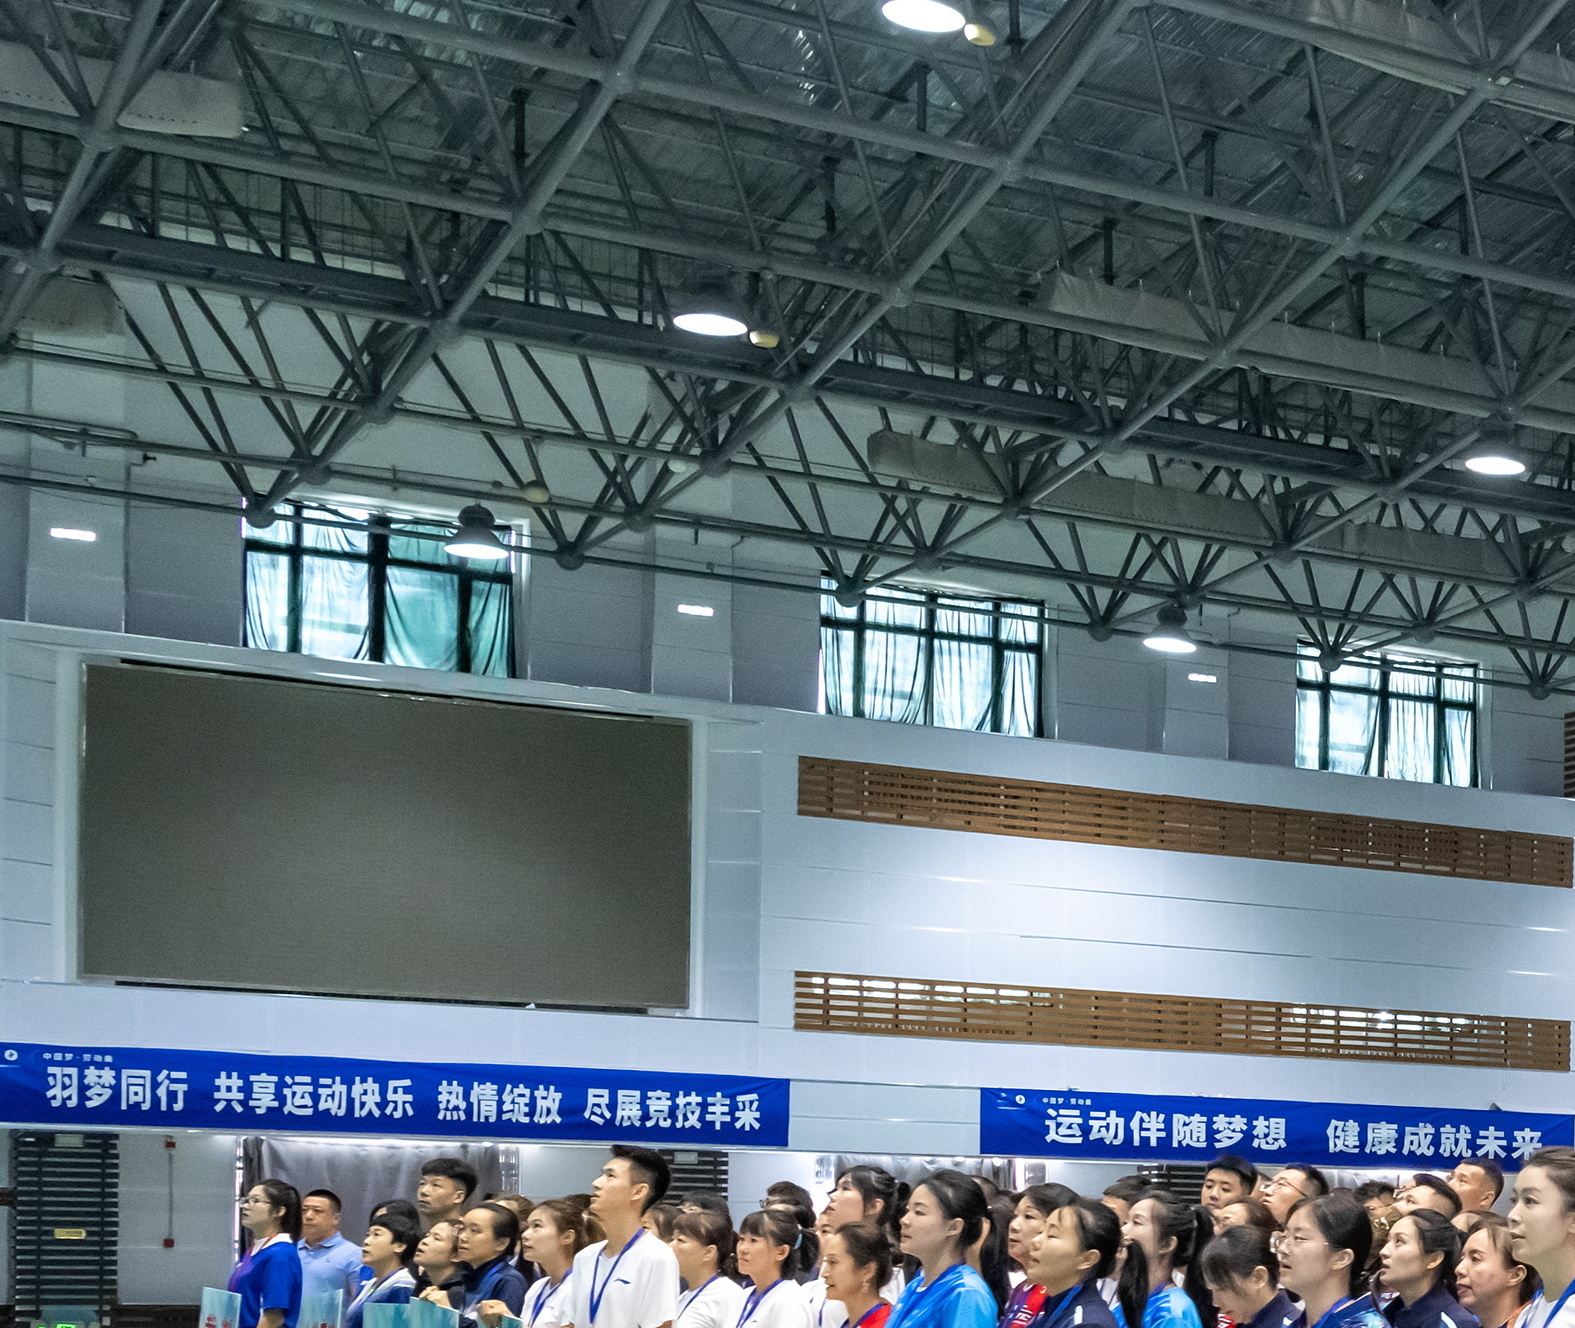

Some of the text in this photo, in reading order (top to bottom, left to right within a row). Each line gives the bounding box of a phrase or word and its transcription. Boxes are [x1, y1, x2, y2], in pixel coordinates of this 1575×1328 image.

[46, 1065, 761, 1132] 羽梦同行 共享运动快乐 热情绽放 尽展竞技丰采
[1044, 1108, 1543, 1161] 运动伴随梦想 健康成就未来
